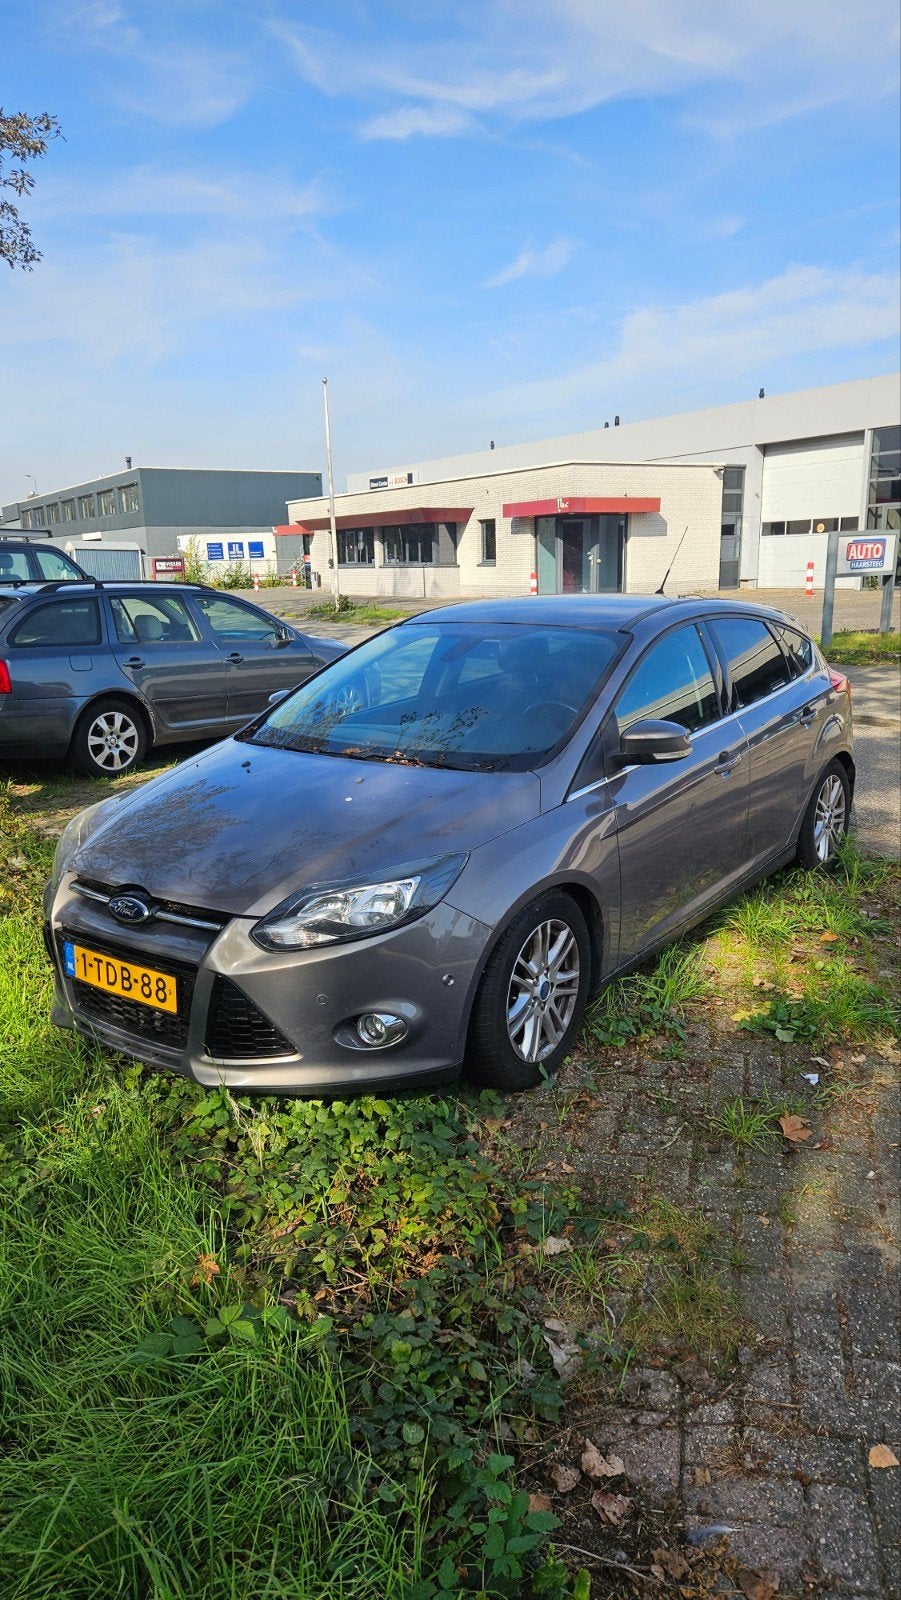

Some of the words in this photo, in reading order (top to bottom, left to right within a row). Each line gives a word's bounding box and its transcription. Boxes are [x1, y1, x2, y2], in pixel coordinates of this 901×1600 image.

[848, 543, 883, 560] AUTO
[851, 560, 883, 569] HAARSTEEG
[114, 899, 138, 916] Ford
[82, 953, 168, 1003] 1-TDB-88
